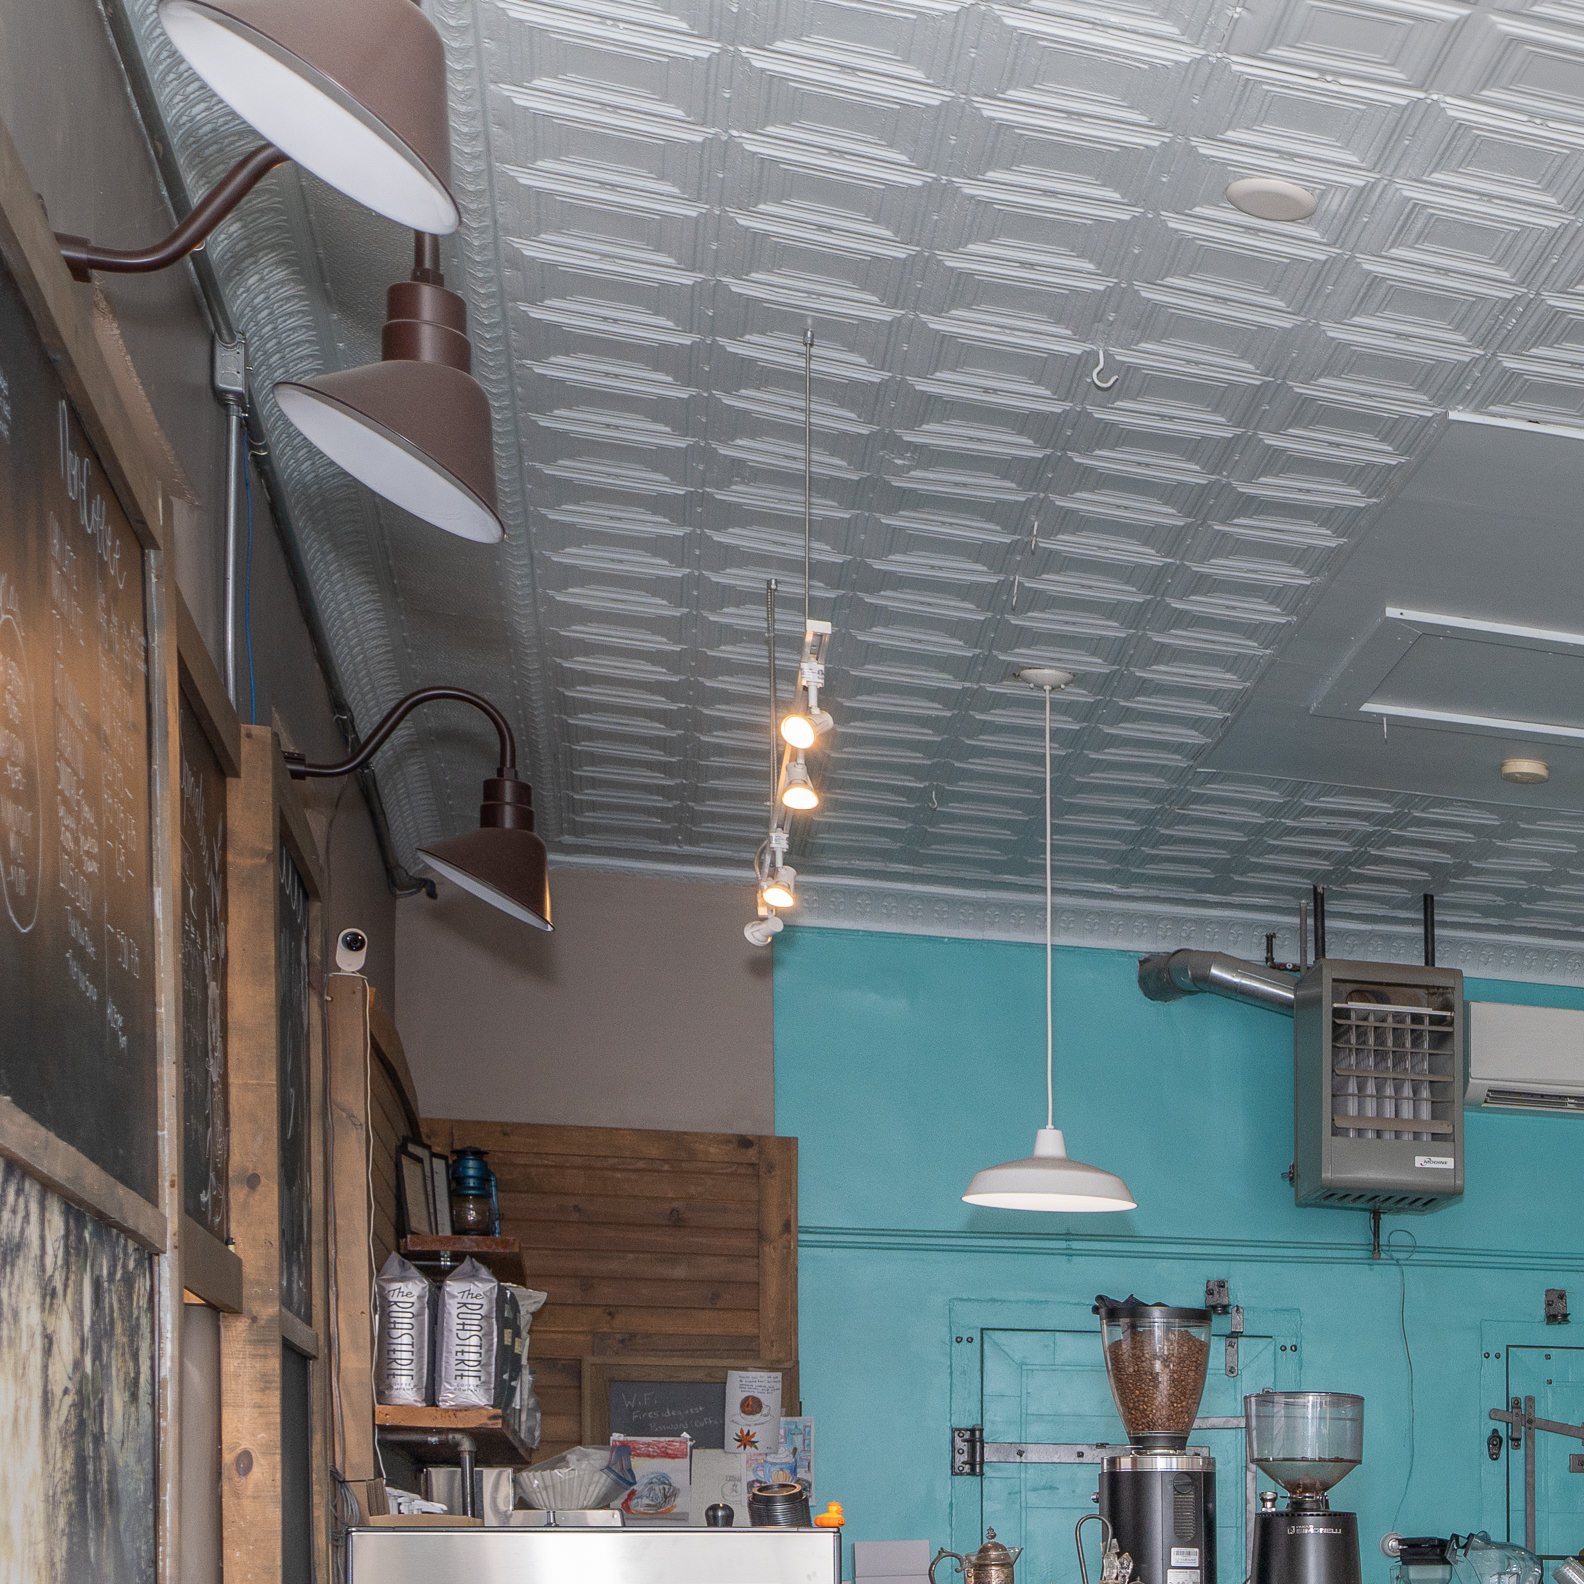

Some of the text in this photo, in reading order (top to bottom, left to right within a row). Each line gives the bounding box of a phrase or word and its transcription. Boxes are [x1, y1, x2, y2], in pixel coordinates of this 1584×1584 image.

[387, 1287, 416, 1299] The
[457, 1287, 485, 1300] The
[386, 1300, 415, 1381] ROASTERIE
[454, 1302, 484, 1382] ROASTERIE
